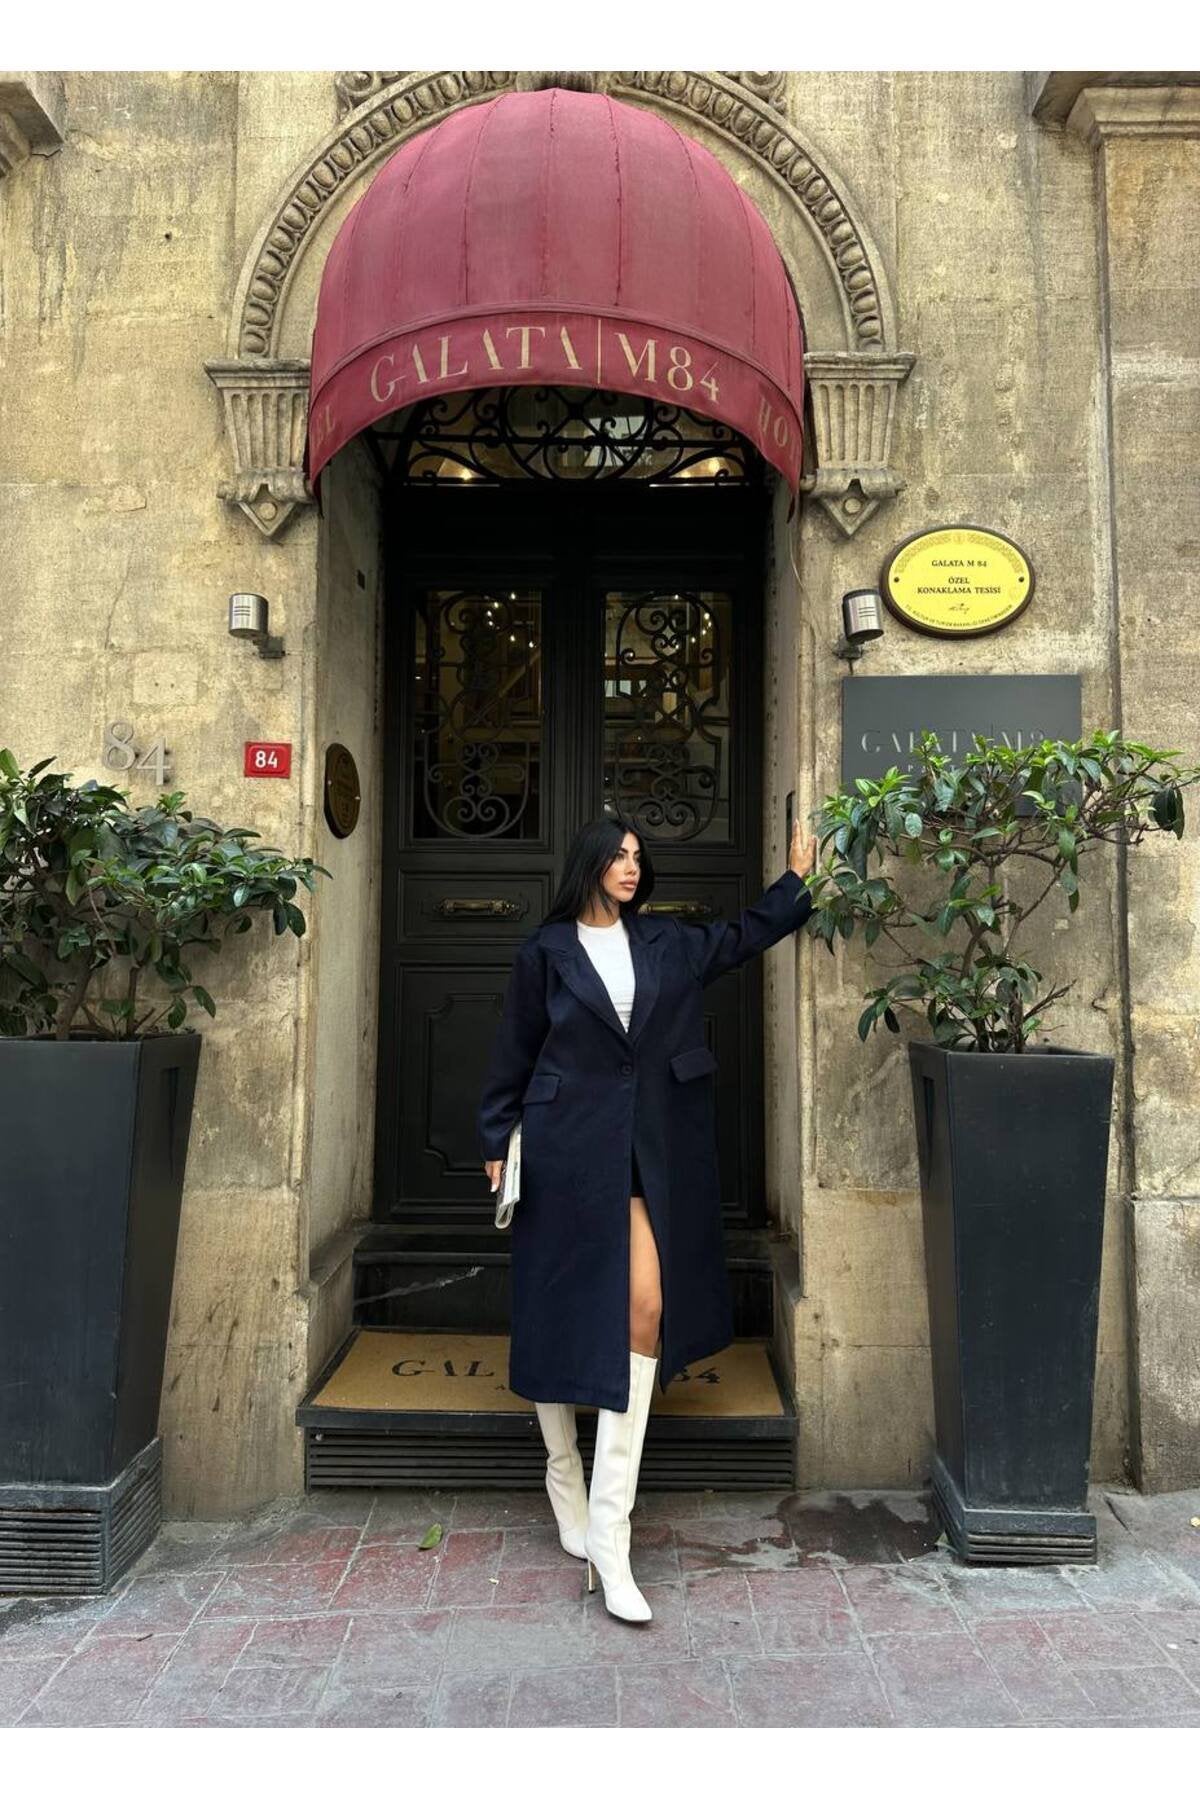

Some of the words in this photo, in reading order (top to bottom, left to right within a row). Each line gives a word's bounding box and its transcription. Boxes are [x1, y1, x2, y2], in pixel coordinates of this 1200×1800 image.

[370, 326, 583, 402] GALATA
[614, 332, 720, 405] M84
[931, 560, 964, 568] GALATA
[967, 560, 975, 568] M
[977, 560, 987, 568] 84
[948, 576, 970, 585] ÖZEL
[917, 587, 972, 595] KONAKLAMA
[105, 720, 172, 786] 84
[255, 750, 279, 769] 84
[391, 1359, 495, 1378] GAL
